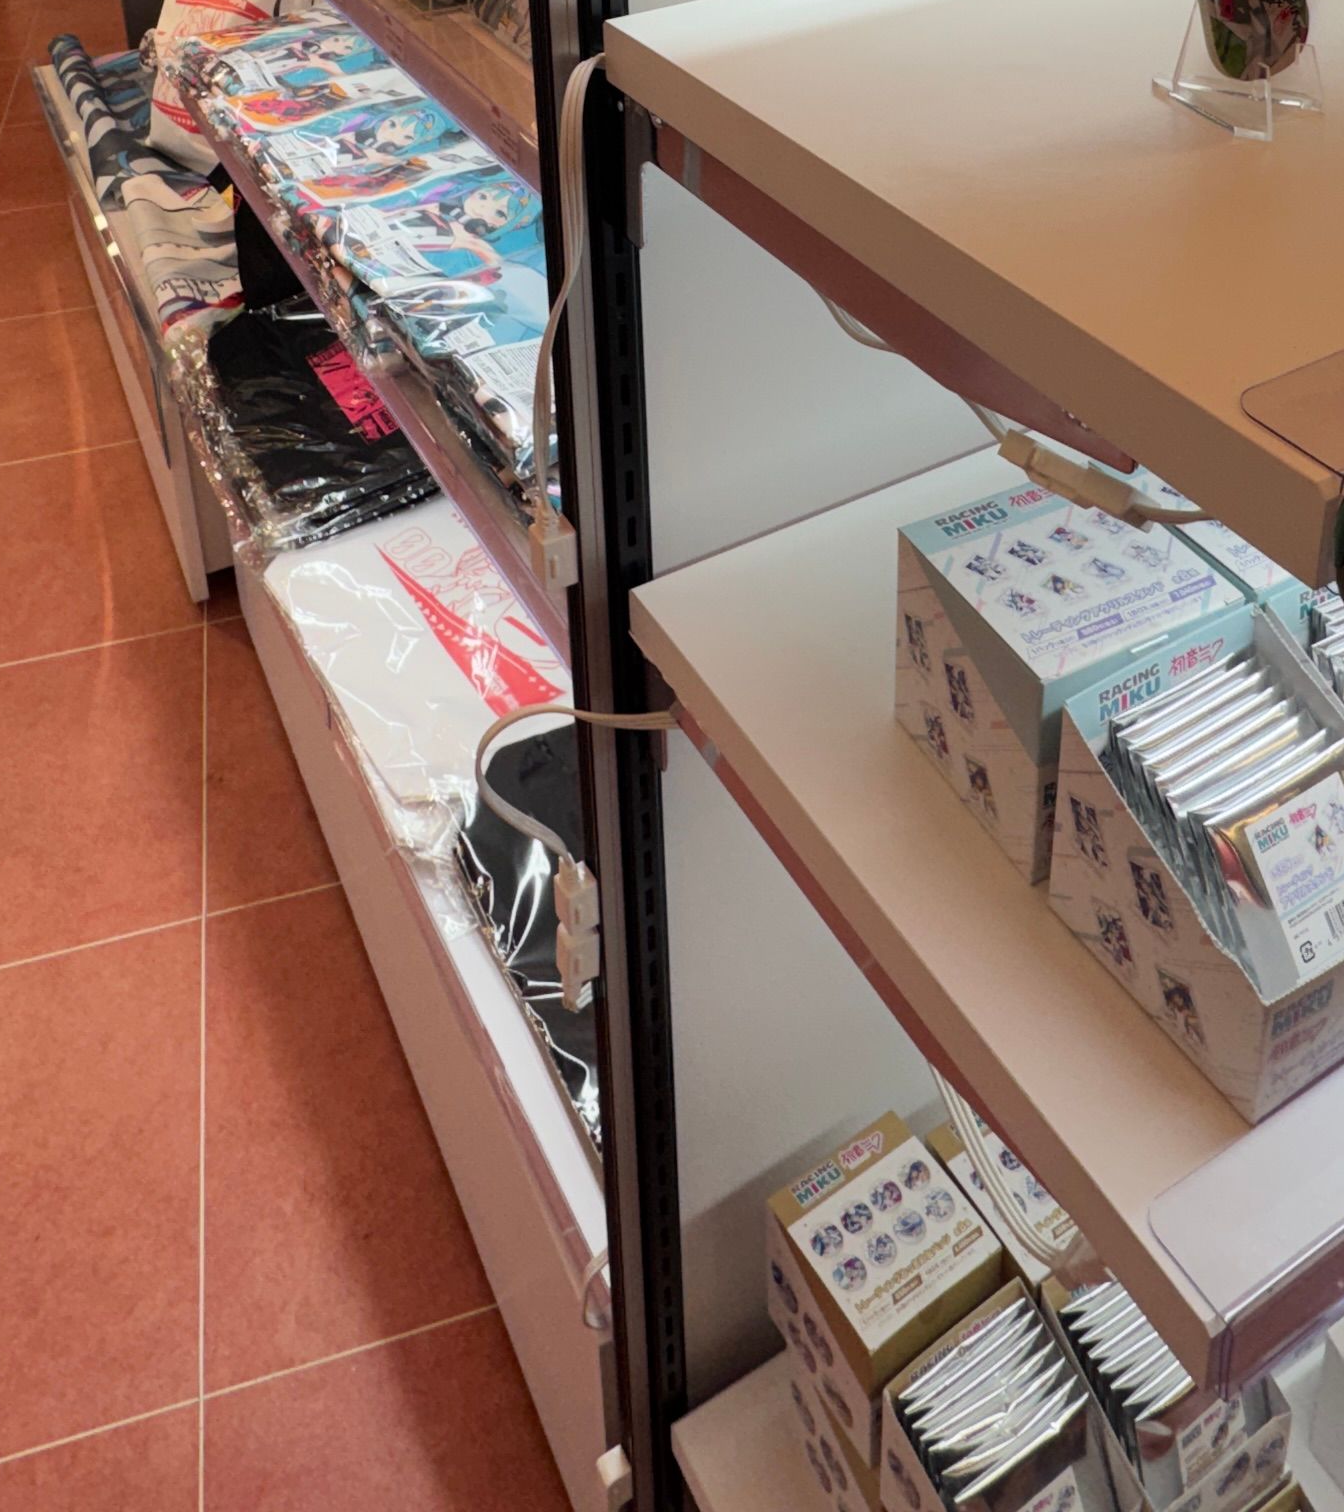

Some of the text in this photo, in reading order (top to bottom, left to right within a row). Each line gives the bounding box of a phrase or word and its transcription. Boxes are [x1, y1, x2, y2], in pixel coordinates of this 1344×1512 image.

[934, 500, 999, 527] RACING
[1008, 488, 1058, 507] 初音ミ
[941, 508, 1009, 537] MIKU
[1168, 637, 1224, 676] 初音ミク
[1099, 663, 1160, 704] RACING
[1099, 676, 1161, 721] MIKU
[1257, 824, 1290, 852] MIKU
[791, 1160, 834, 1194] RACING
[796, 1167, 841, 1204] MIKU
